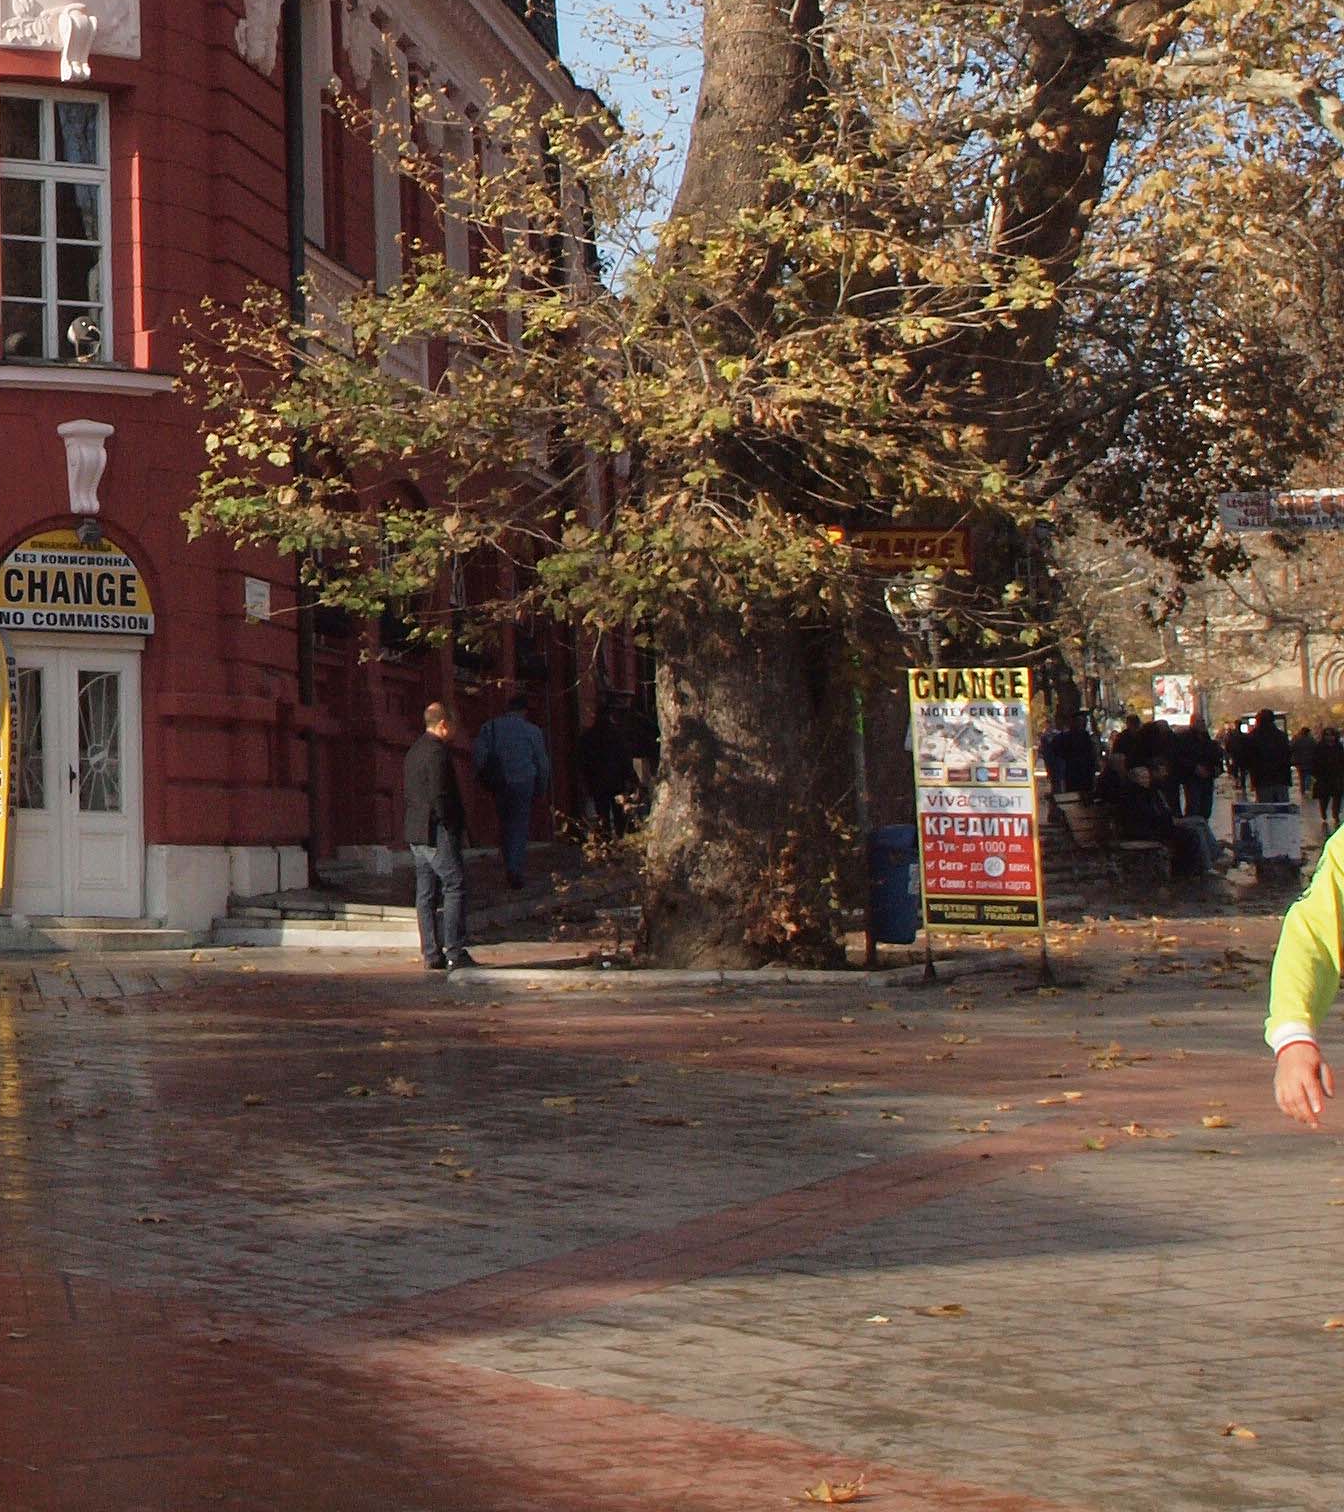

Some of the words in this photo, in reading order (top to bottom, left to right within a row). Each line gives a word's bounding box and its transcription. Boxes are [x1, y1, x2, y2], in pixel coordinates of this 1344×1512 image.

[14, 552, 37, 564] БЕЗ
[4, 568, 137, 607] CHANGE
[0, 610, 25, 626] NO
[32, 611, 149, 630] COMMISSION
[913, 670, 1024, 700] CHANGE
[920, 707, 965, 717] MONEY
[968, 707, 1019, 717] CENTER
[925, 816, 1029, 837] КРЕДИТИ
[979, 841, 1007, 854] 1000
